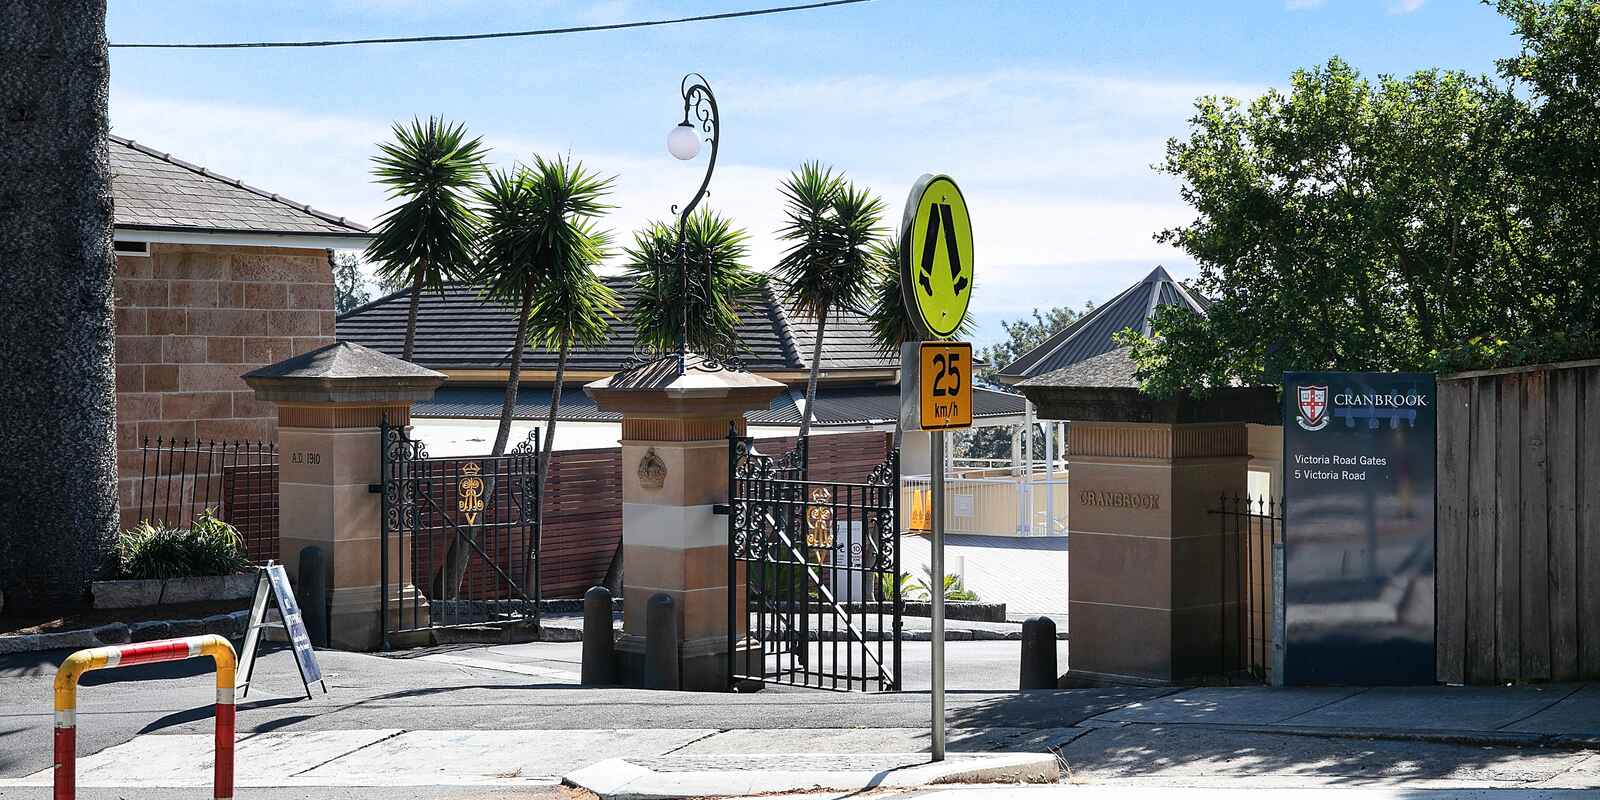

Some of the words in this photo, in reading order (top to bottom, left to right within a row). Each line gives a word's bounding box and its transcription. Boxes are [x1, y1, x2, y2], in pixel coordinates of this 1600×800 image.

[933, 353, 960, 397] 25
[1334, 393, 1428, 408] CRANBROOK
[935, 401, 958, 418] km/h
[1294, 454, 1330, 465] Victoria
[1333, 455, 1357, 465] Road
[1359, 455, 1387, 466] Gates
[1294, 470, 1301, 480] 5
[1303, 469, 1339, 480] Victoria
[1342, 471, 1366, 481] Road
[1080, 490, 1160, 509] CRANBROOK
